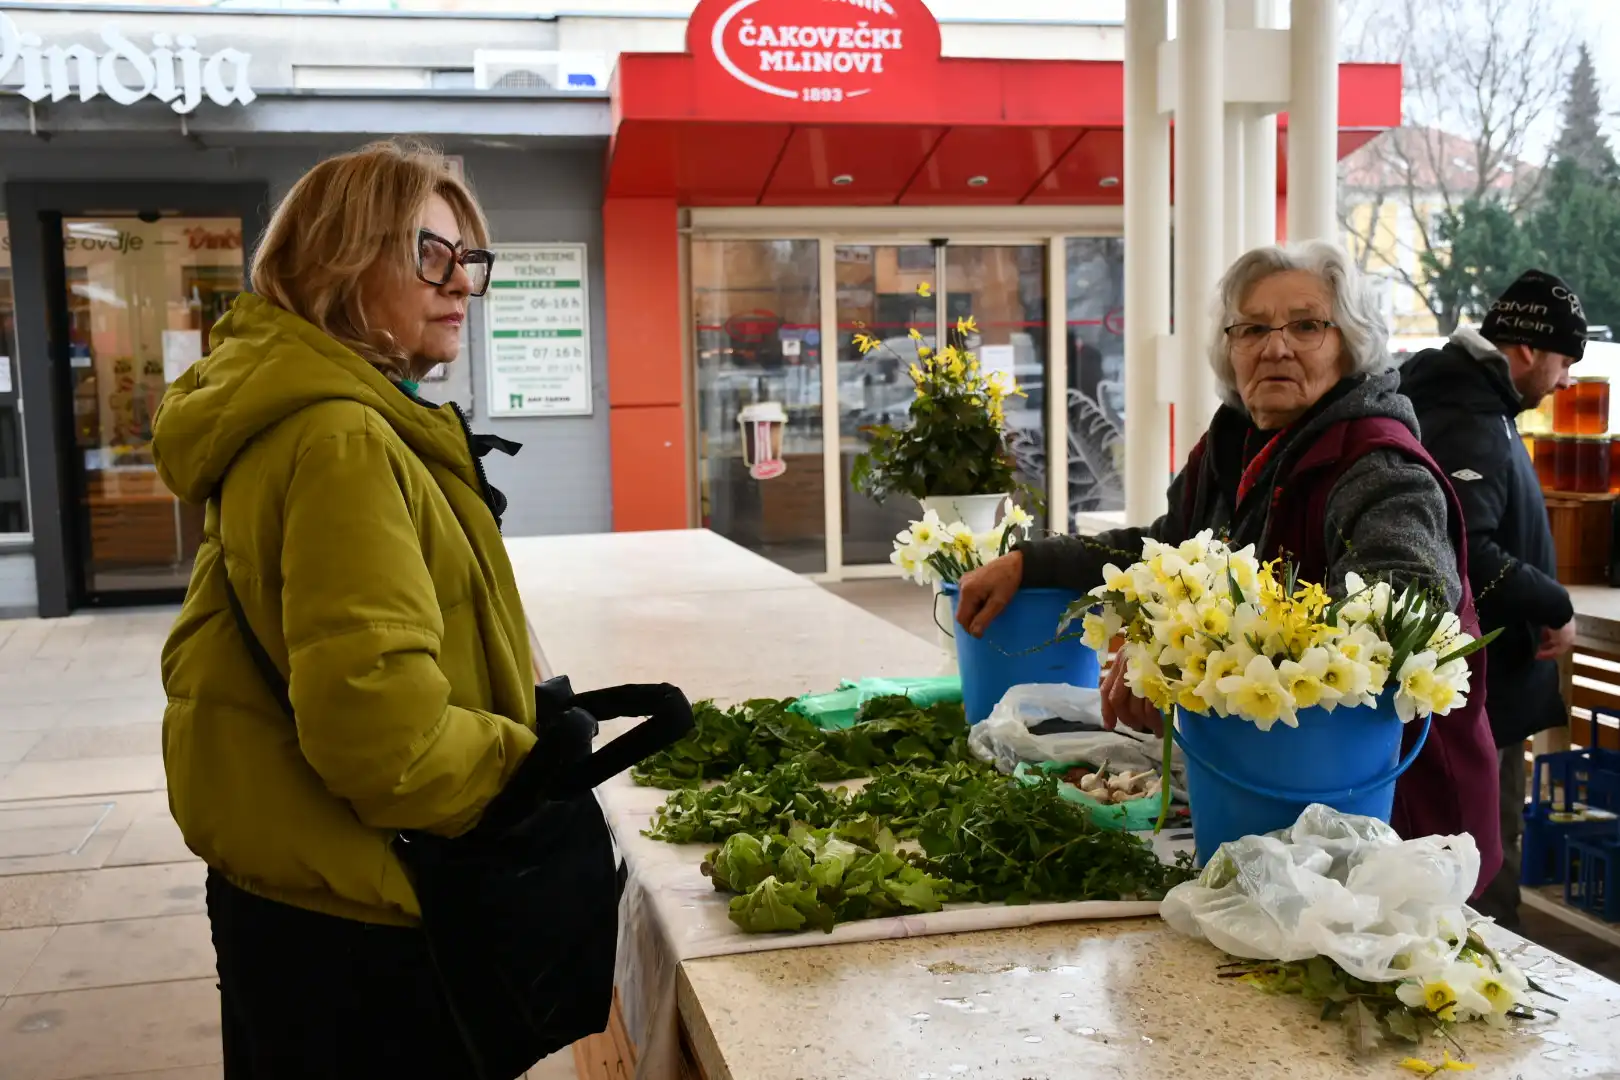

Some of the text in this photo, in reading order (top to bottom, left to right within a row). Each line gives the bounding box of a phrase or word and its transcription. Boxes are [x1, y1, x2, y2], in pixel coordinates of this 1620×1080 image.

[738, 18, 902, 49] ČAKOVEČKI
[759, 50, 883, 73] MLINOVI
[802, 87, 842, 102] 1893
[1496, 314, 1554, 334] Klein
